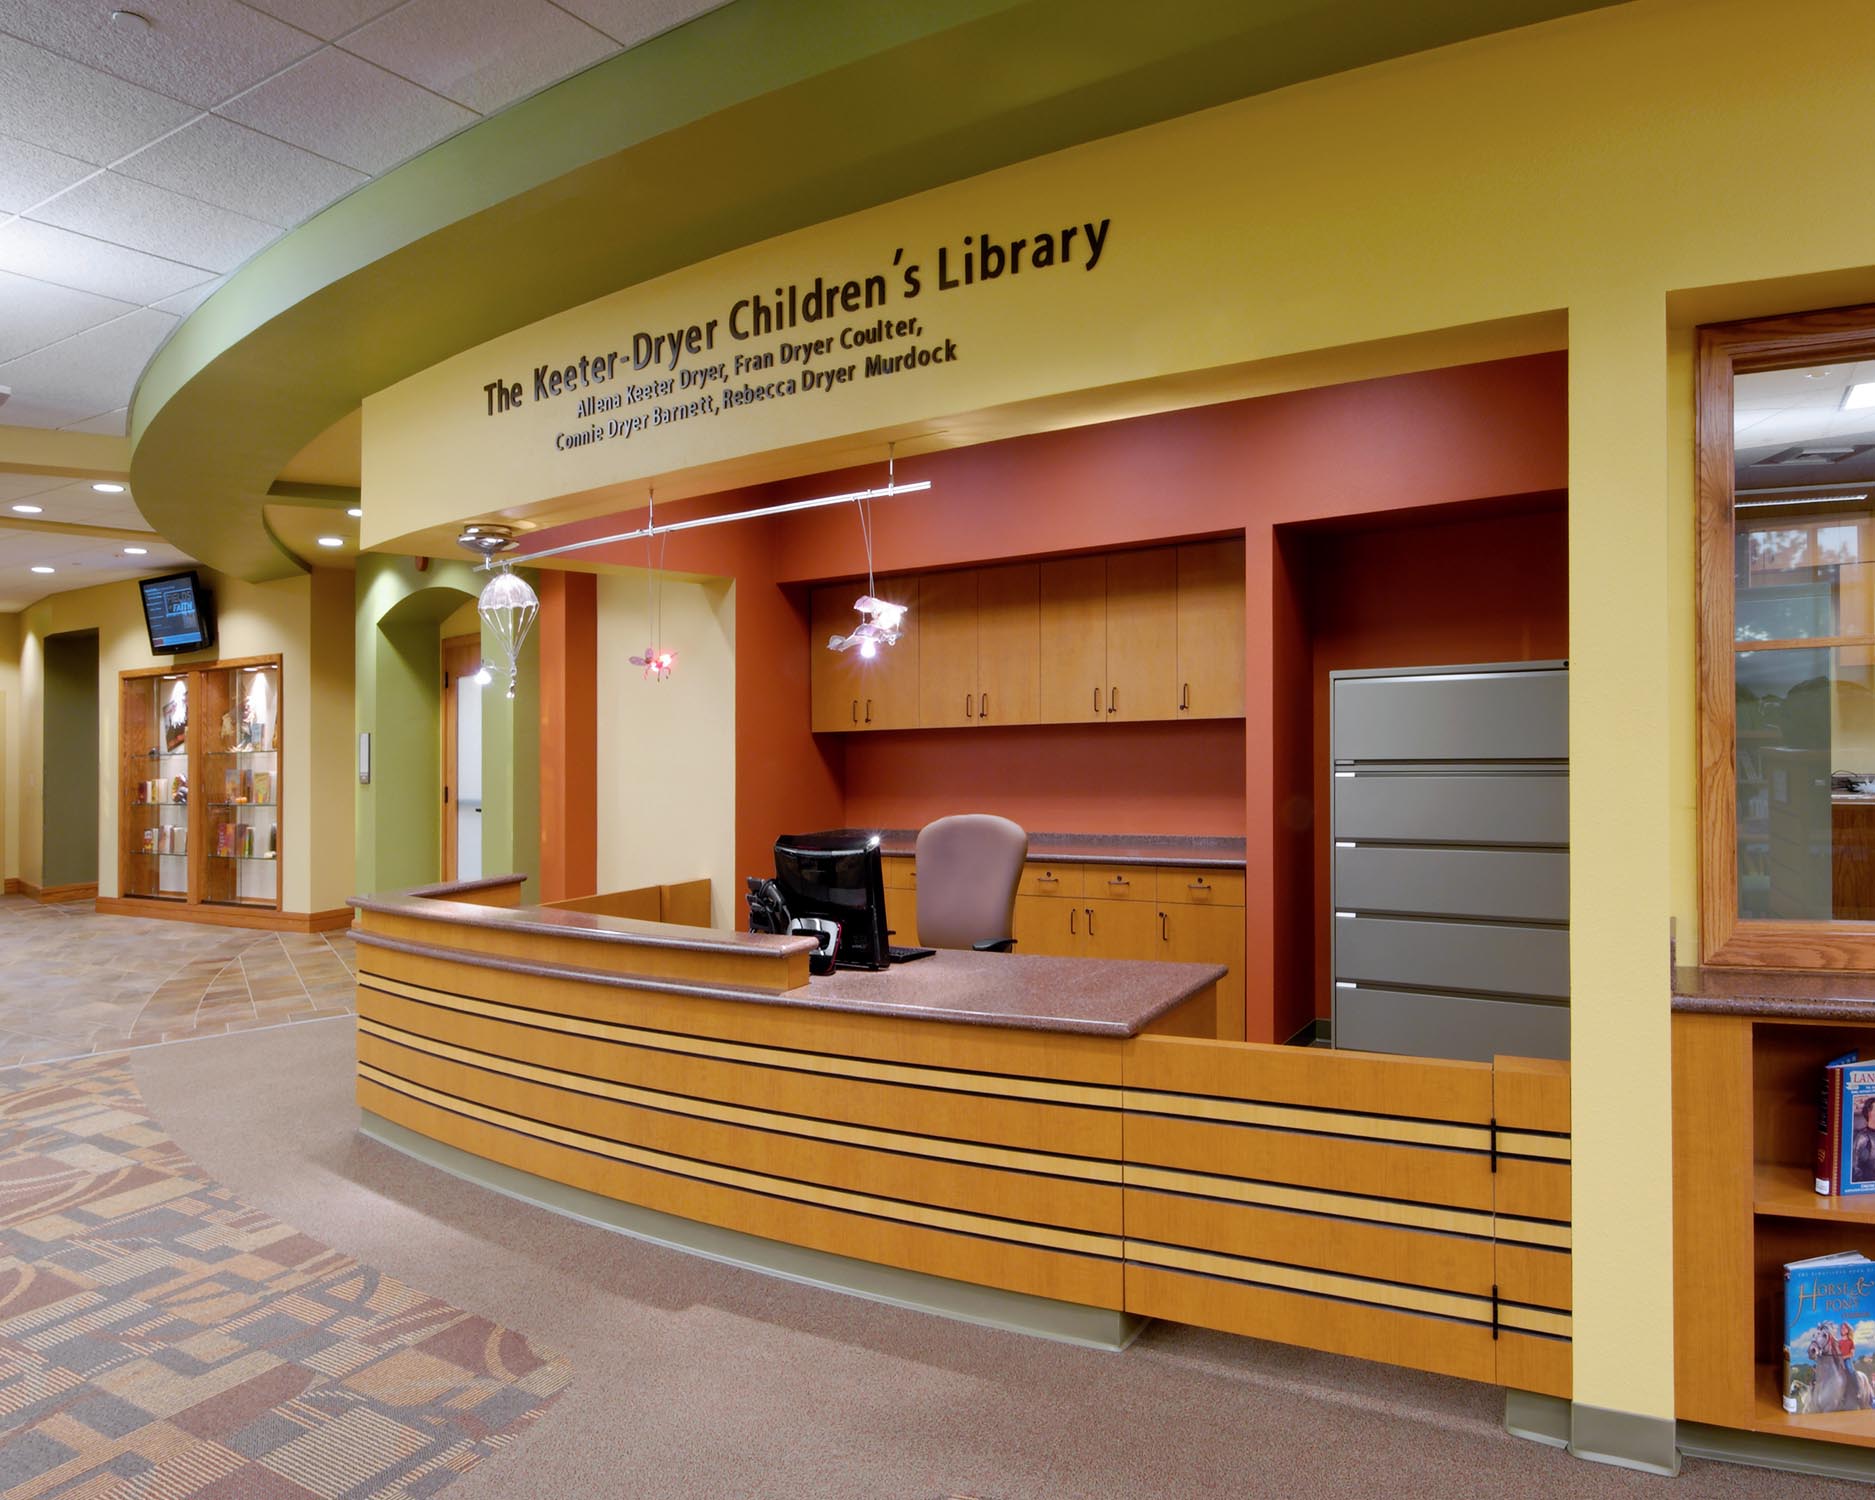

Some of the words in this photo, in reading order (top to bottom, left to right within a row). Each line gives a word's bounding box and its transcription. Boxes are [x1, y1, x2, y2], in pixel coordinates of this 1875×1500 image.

[484, 379, 523, 416] The
[534, 319, 718, 401] Keeter-Dryer
[729, 248, 921, 340] Children's
[938, 218, 1111, 291] Library
[577, 394, 622, 419] Allena
[627, 378, 675, 405] Keeter
[680, 363, 728, 390] Dryer,
[734, 351, 774, 376] Fran
[780, 337, 834, 365] Dryer
[840, 317, 922, 350] Coulter,
[556, 424, 604, 451] Connie
[607, 414, 650, 439] Dryer
[653, 395, 720, 427] Barnett,
[723, 379, 796, 410] Rebecca
[802, 364, 856, 392] Dryer
[865, 338, 957, 378] Murdock
